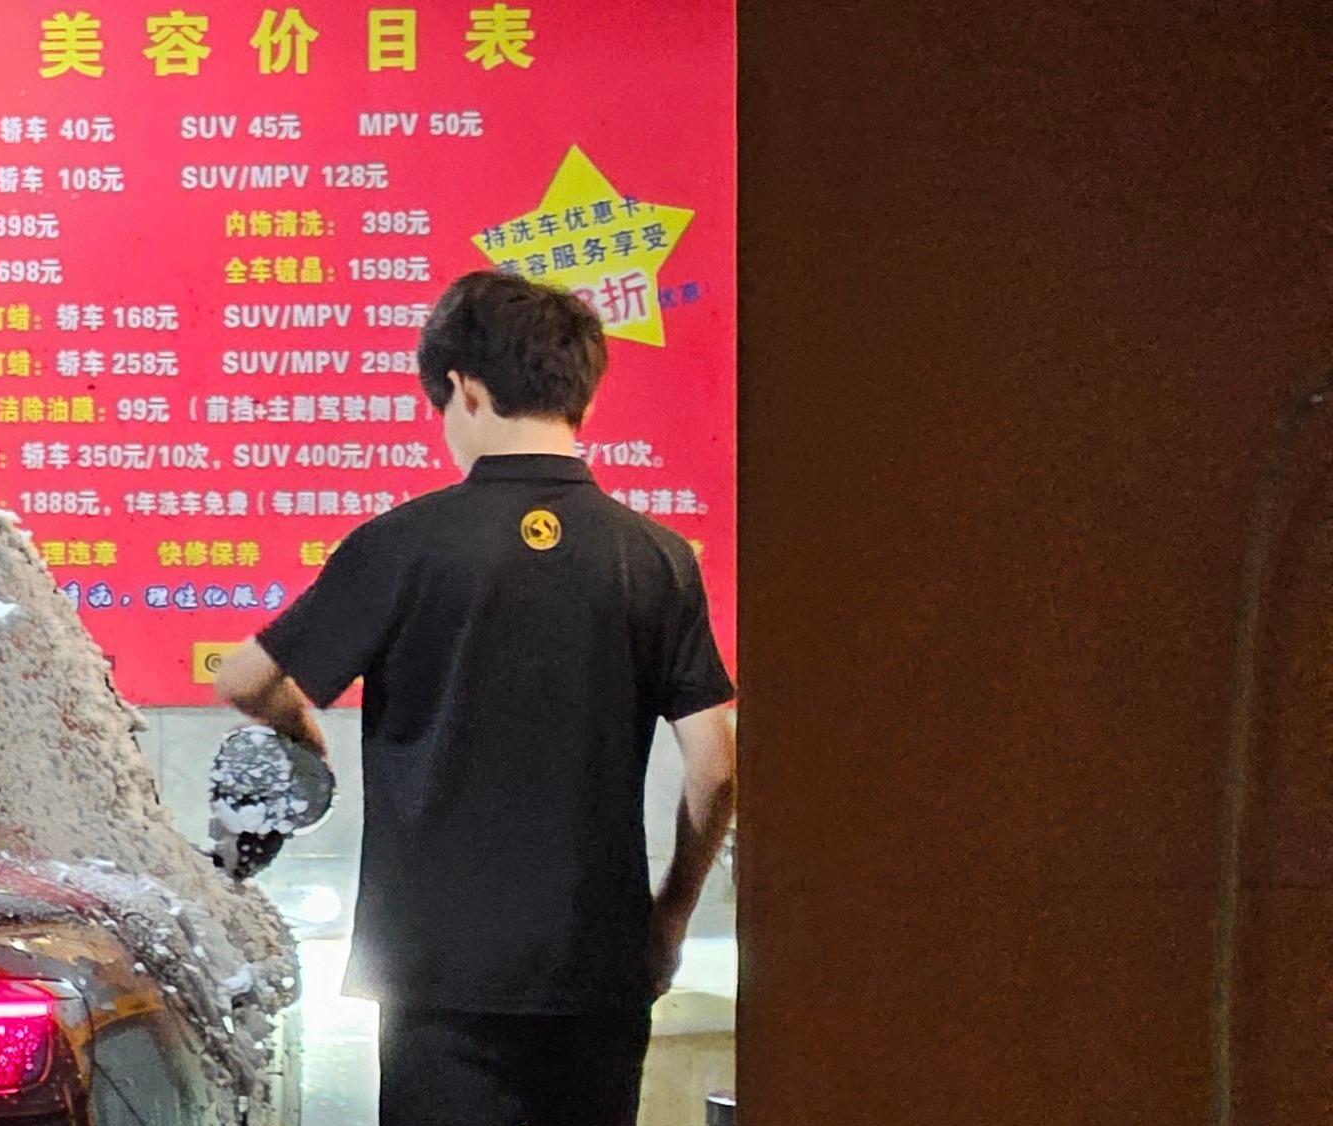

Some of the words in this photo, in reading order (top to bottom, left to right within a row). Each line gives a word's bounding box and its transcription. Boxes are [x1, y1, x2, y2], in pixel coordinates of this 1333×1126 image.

[38, 3, 536, 79] 美容价目表
[0, 115, 48, 143] 轿车
[59, 116, 115, 142] 40元
[181, 115, 237, 140] SUV
[248, 113, 301, 140] 45元
[359, 111, 418, 137] MPV
[429, 110, 483, 137] 50元
[58, 165, 124, 192] 108元
[181, 164, 309, 191] SUV/MPV
[321, 162, 389, 189] 128元
[362, 209, 430, 236] 398元
[348, 256, 430, 282] 1598元
[56, 303, 105, 331] 轿车
[112, 303, 179, 331] 168元
[223, 303, 351, 330] SUV/MPV
[56, 349, 105, 377] 轿车
[111, 350, 179, 377] 258元
[222, 350, 350, 376] SUV/MPV
[117, 396, 170, 423] 99元
[21, 441, 71, 470] 轿车
